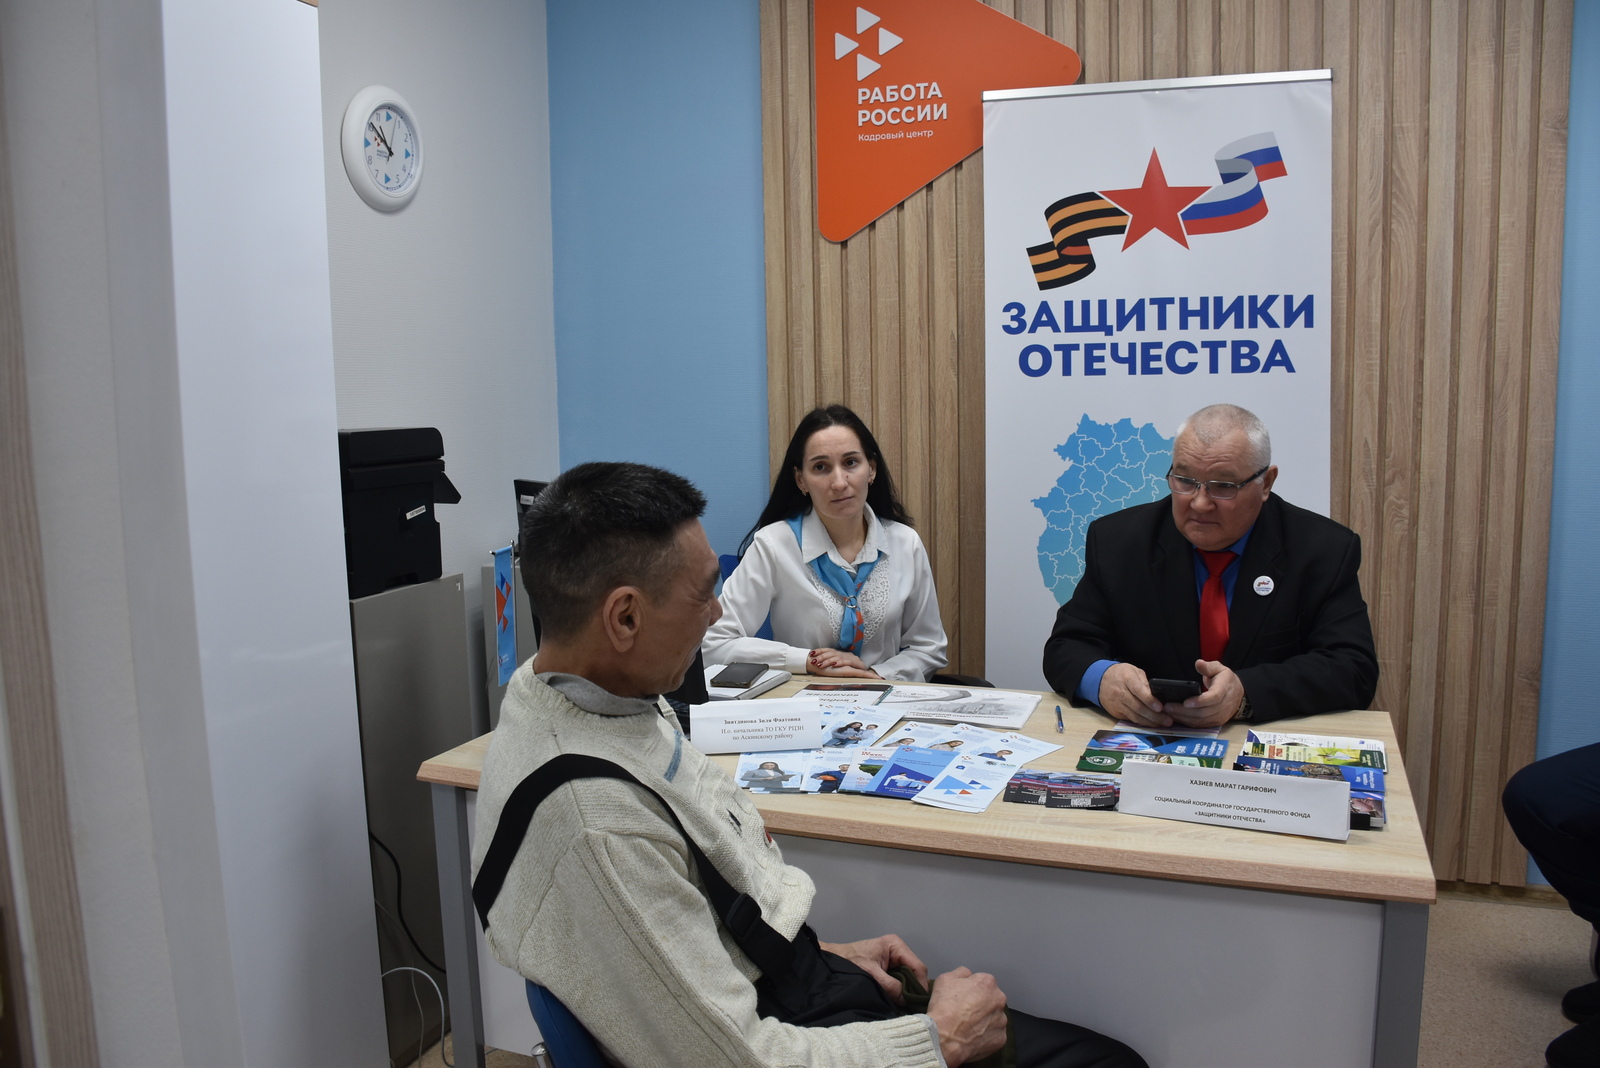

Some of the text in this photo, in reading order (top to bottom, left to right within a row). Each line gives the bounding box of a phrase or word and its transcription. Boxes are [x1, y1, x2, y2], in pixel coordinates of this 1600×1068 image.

[858, 82, 942, 105] РАБОТА
[858, 103, 948, 127] РОССИИ
[858, 130, 934, 142] Кадровый центр
[367, 155, 372, 165] 8
[375, 169, 379, 178] 7
[396, 174, 400, 184] 5
[1002, 294, 1314, 336] ЗАЩИТНИКИ
[1018, 339, 1296, 378] ОТЕЧЕСТВА
[1189, 779, 1277, 794] ХАЗИЕВ МАРАТ ГАРИФОВИЧ
[1154, 796, 1311, 819] СОЦИАЛЬНЫЙ КООРДИНАТОР ГОСУДАРСТВЕННОГО ФОНДА
[1194, 811, 1266, 824] «ЗАЩИТНИКИ ОТЕЧЕСТВА»
